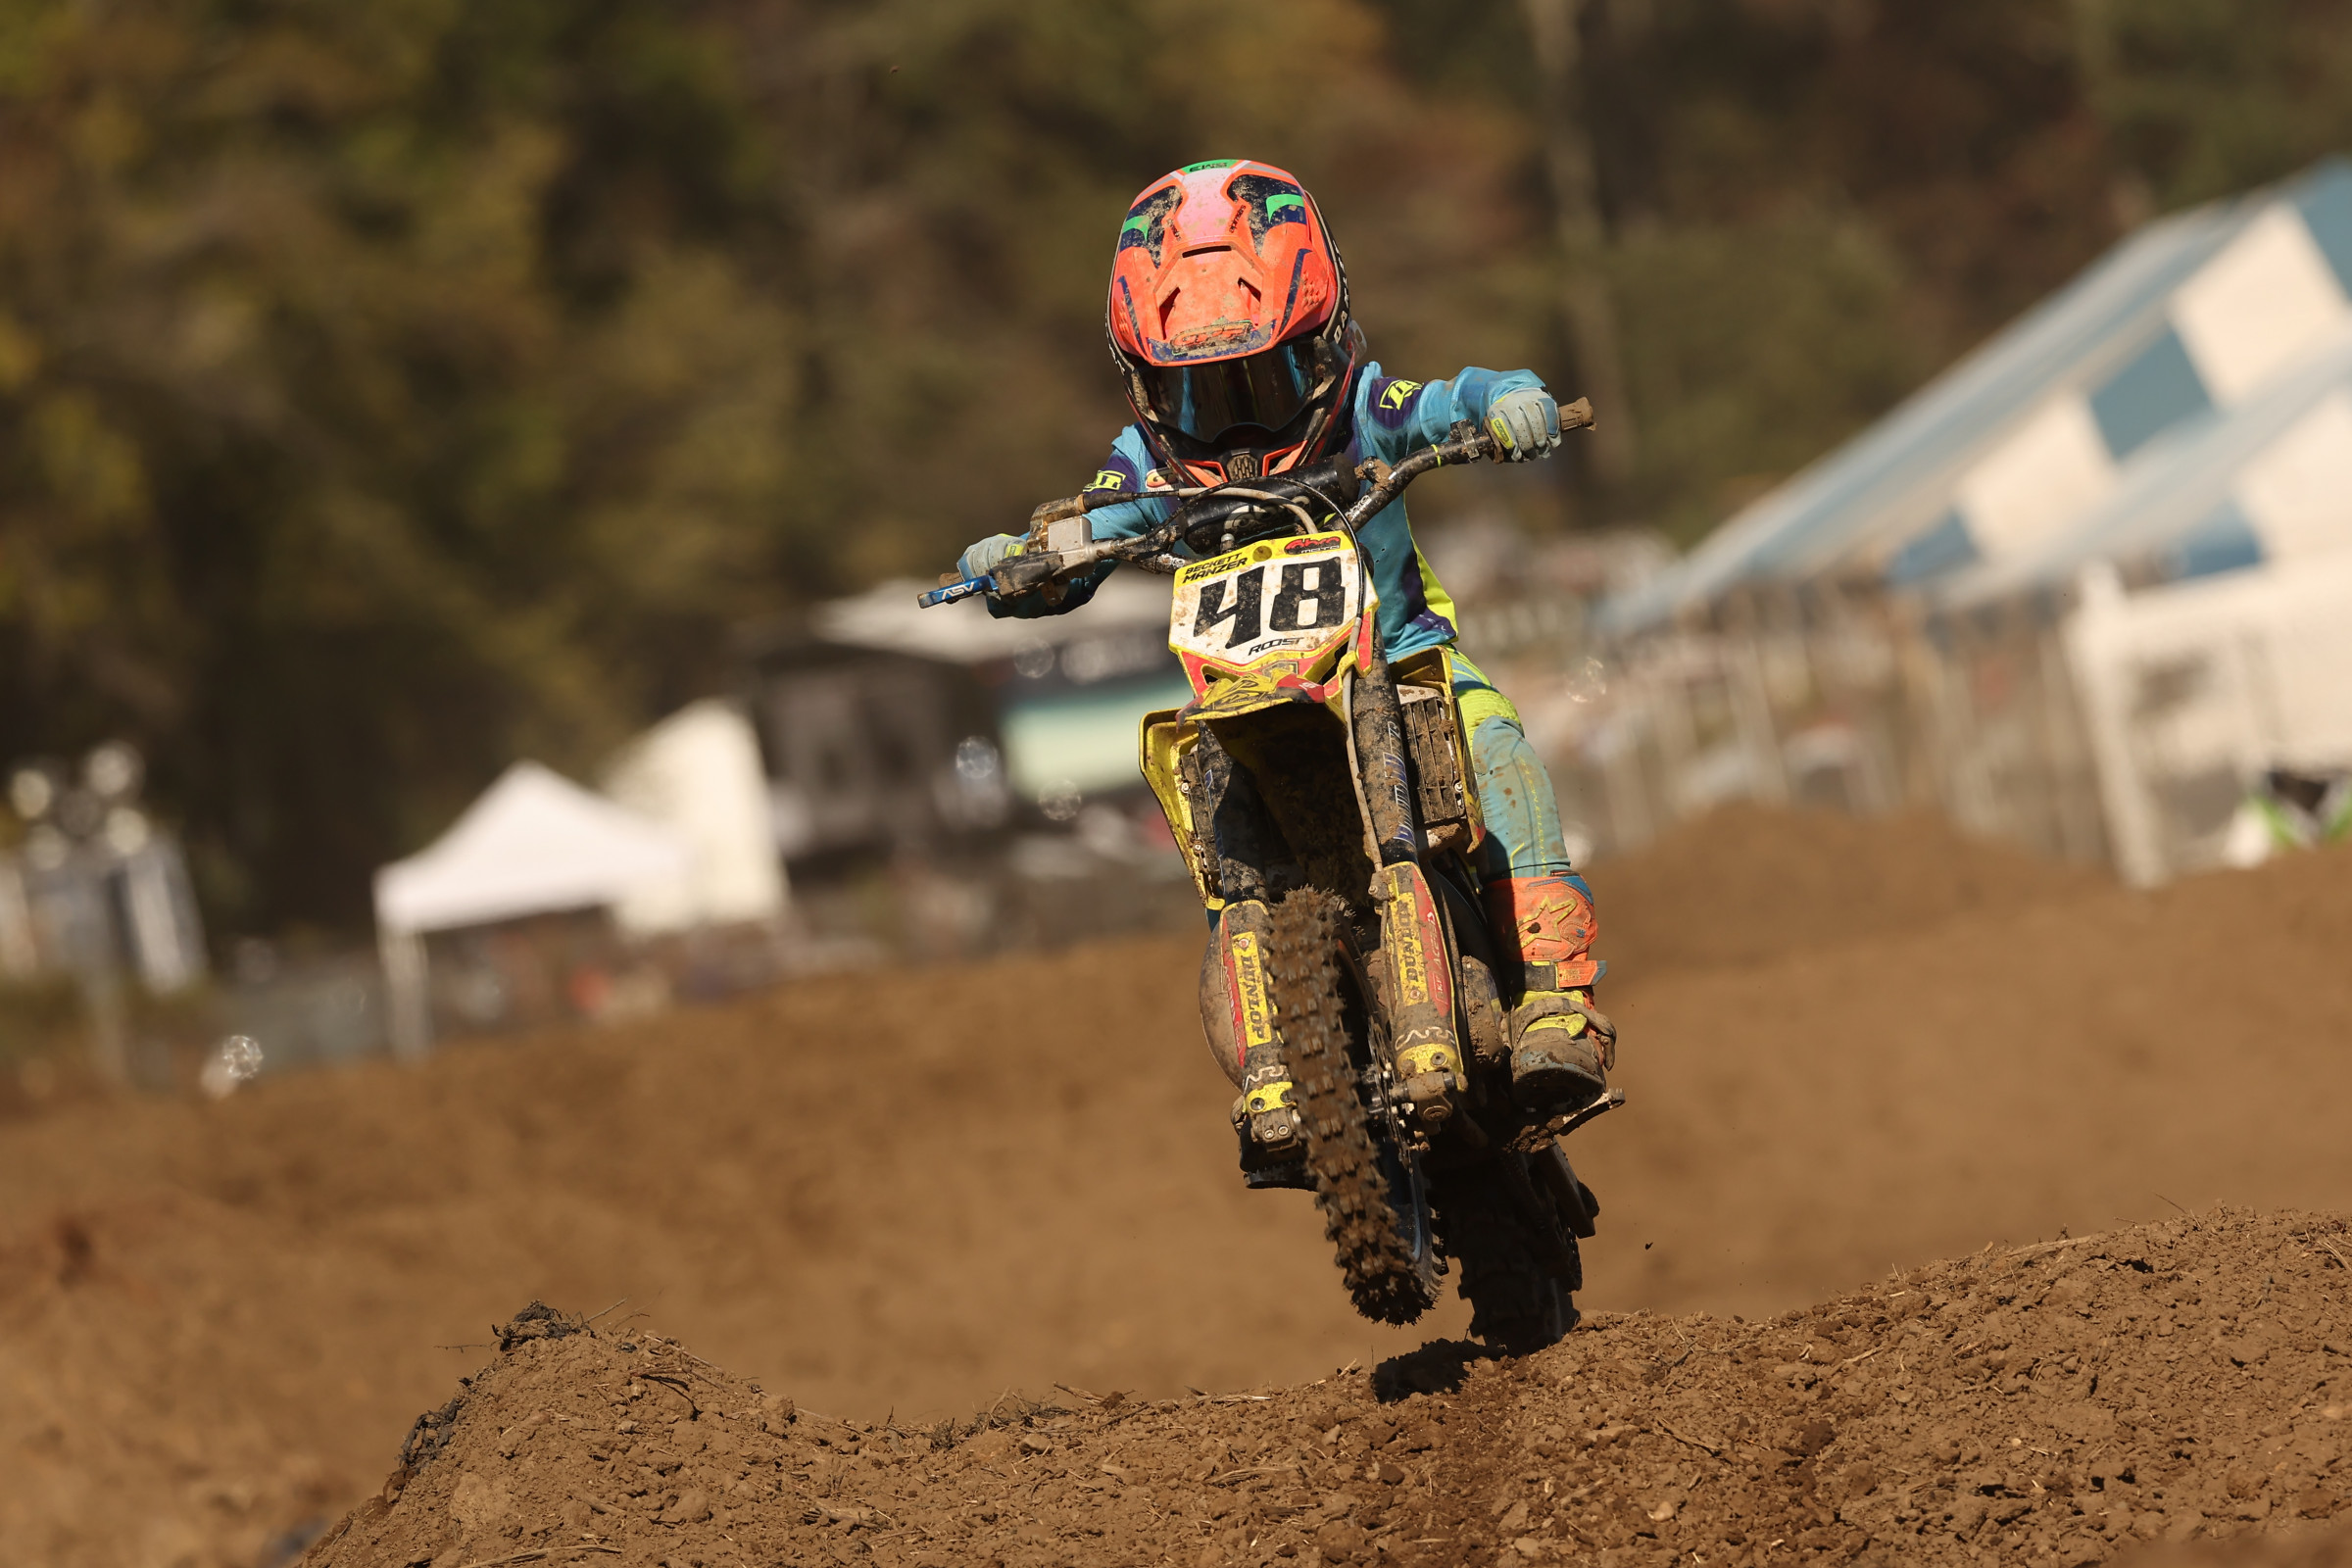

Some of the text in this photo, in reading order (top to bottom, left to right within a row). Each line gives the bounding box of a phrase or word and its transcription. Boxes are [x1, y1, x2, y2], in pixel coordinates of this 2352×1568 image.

[1183, 557, 1249, 584] MANZER
[1185, 553, 1243, 575] BECKETT
[941, 581, 975, 601] ASV
[1193, 556, 1347, 650] 48
[1248, 637, 1304, 656] ROOST
[1241, 955, 1265, 1040] DUNLOP
